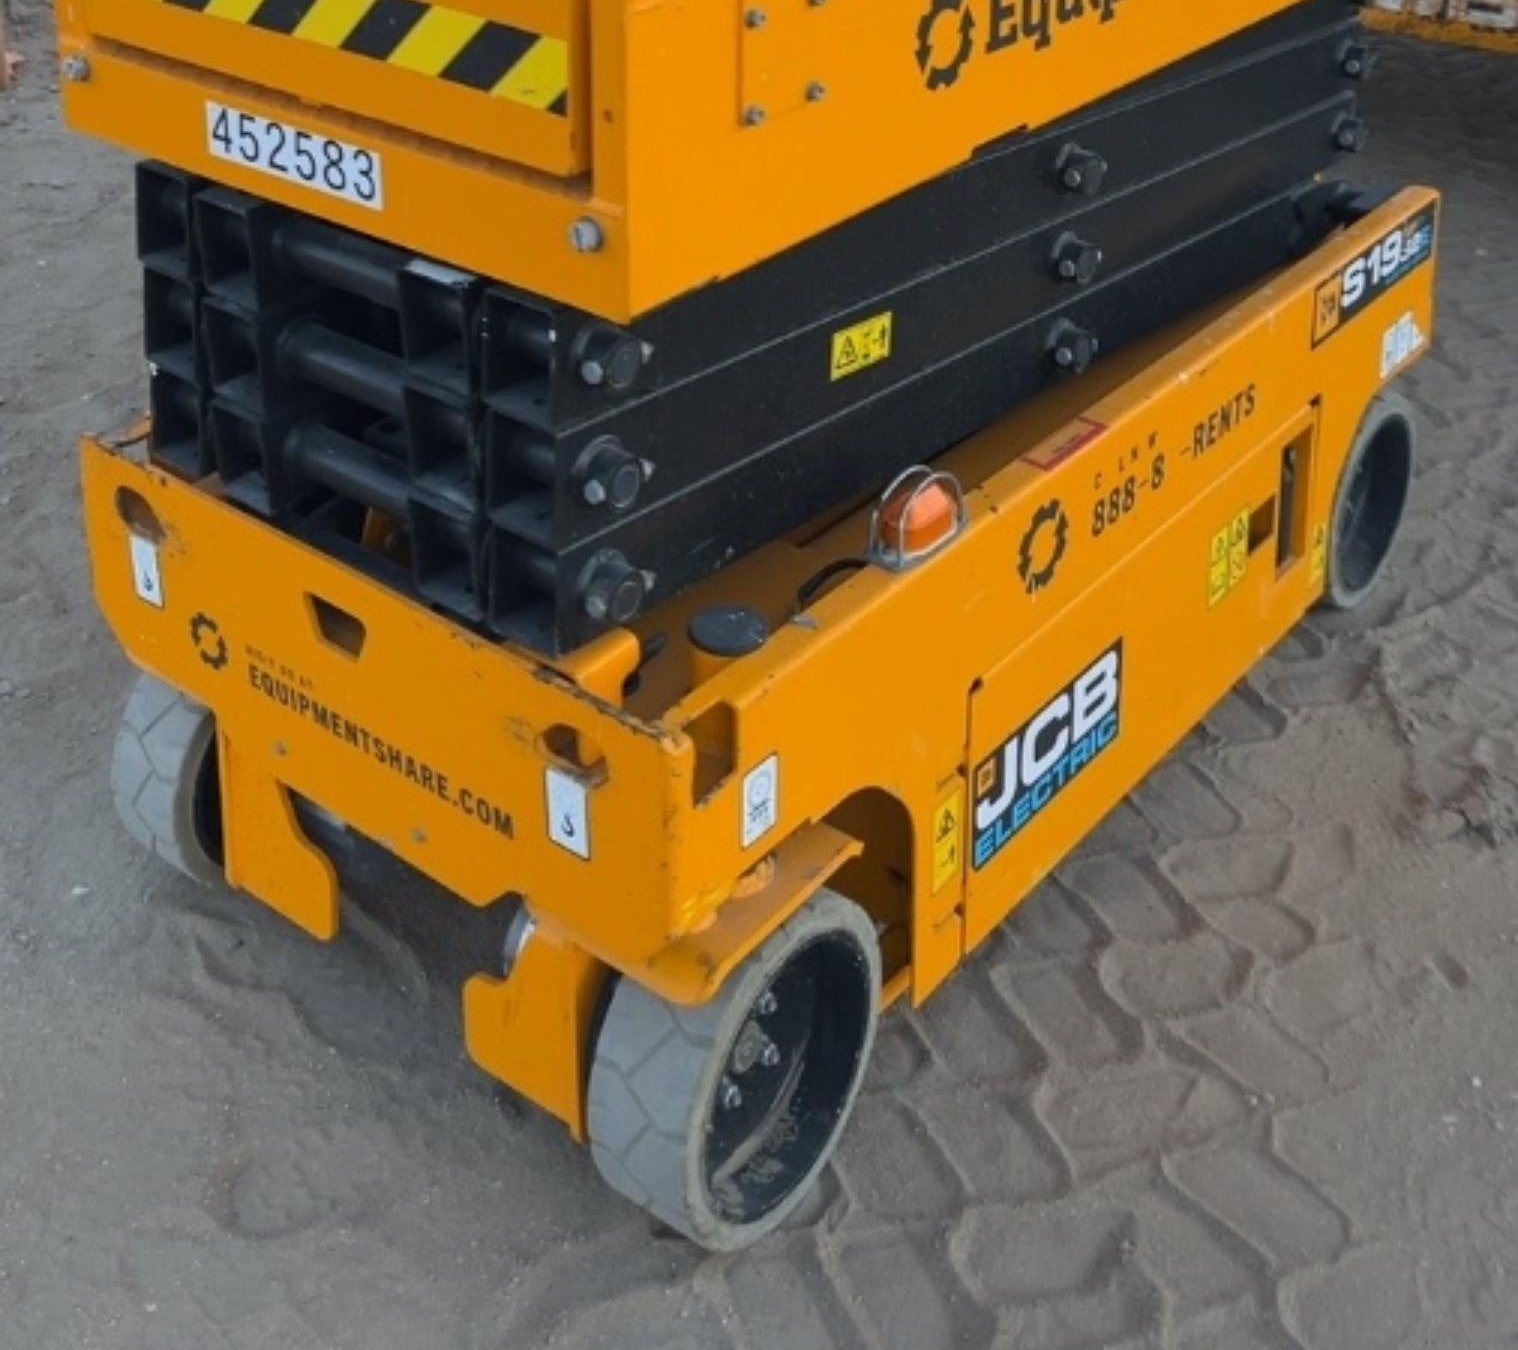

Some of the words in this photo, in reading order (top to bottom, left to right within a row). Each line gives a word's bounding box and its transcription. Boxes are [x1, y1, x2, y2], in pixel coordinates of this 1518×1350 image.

[212, 107, 377, 201] 452583
[248, 662, 514, 840] EQUIPMENTSHARE.COM
[973, 710, 1118, 868] ELECTRIC
[976, 650, 1118, 830] JCB
